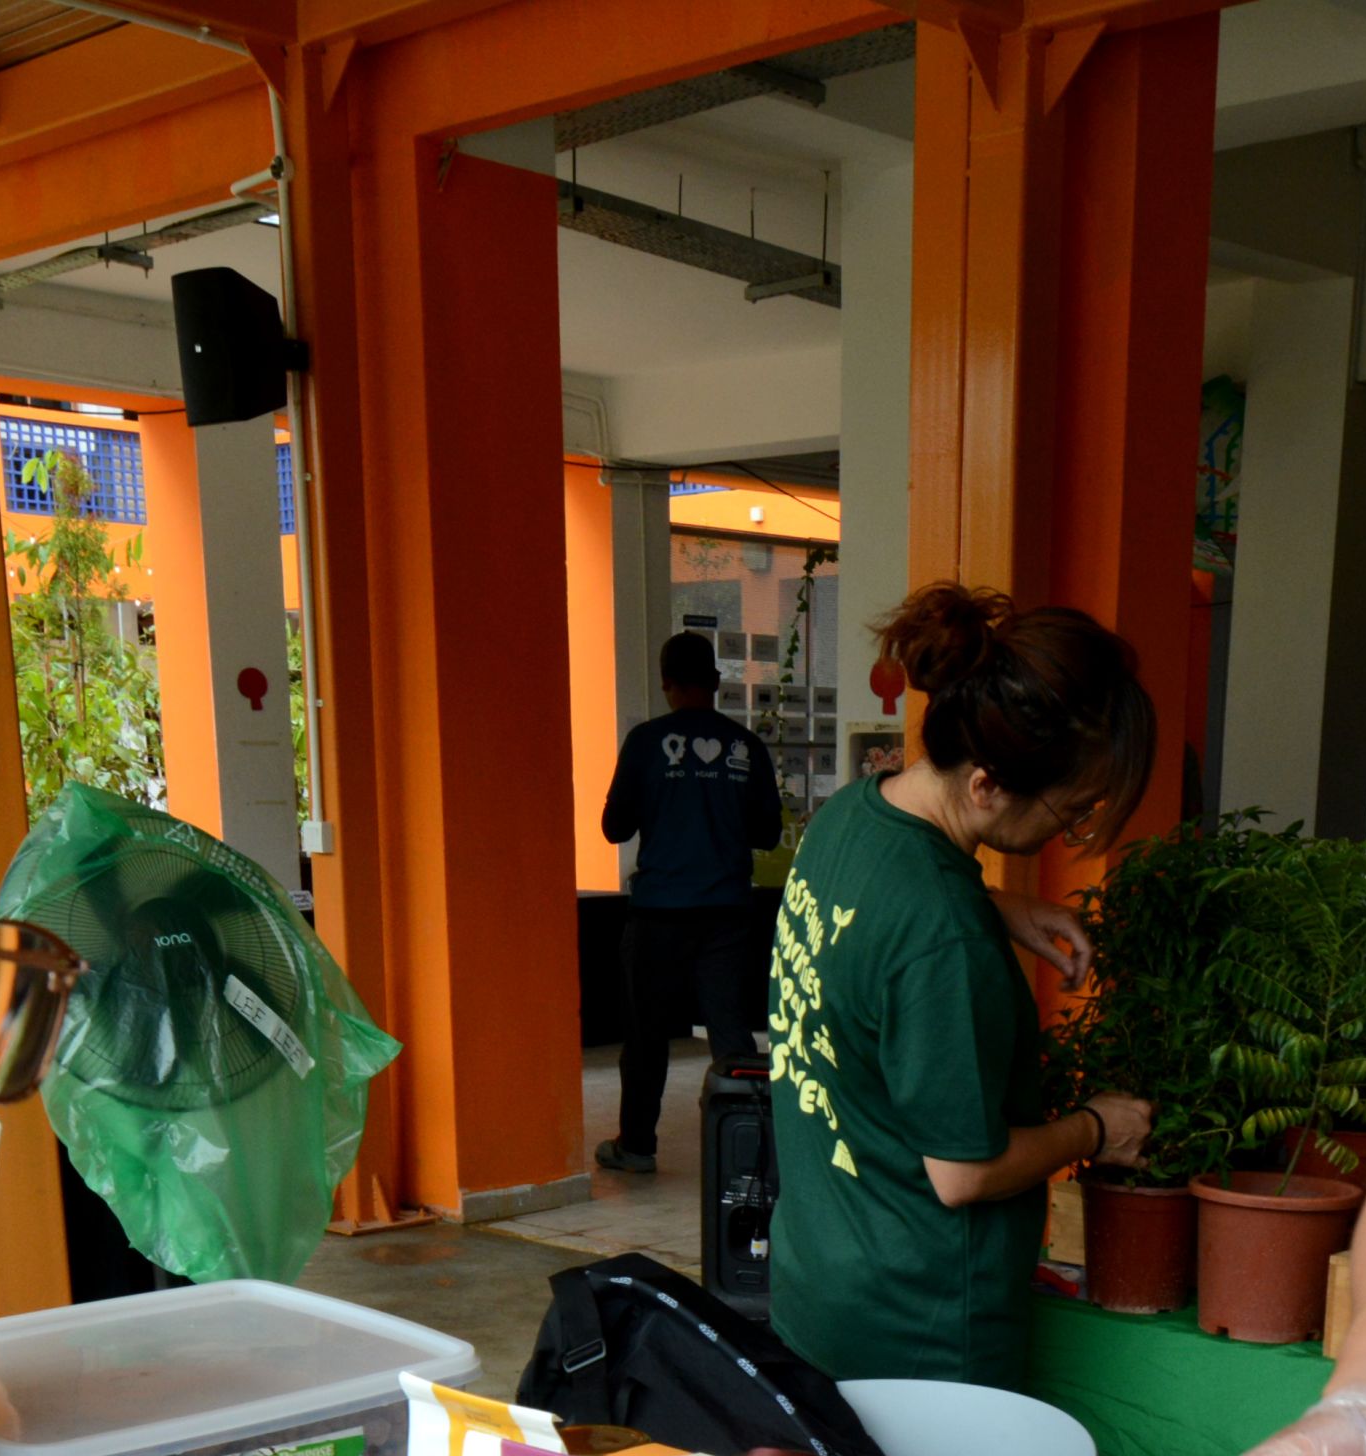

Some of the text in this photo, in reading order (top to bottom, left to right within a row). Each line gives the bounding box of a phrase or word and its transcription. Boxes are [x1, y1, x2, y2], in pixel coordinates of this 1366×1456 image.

[154, 933, 191, 948] iona
[232, 990, 304, 1063] LEE LEE
